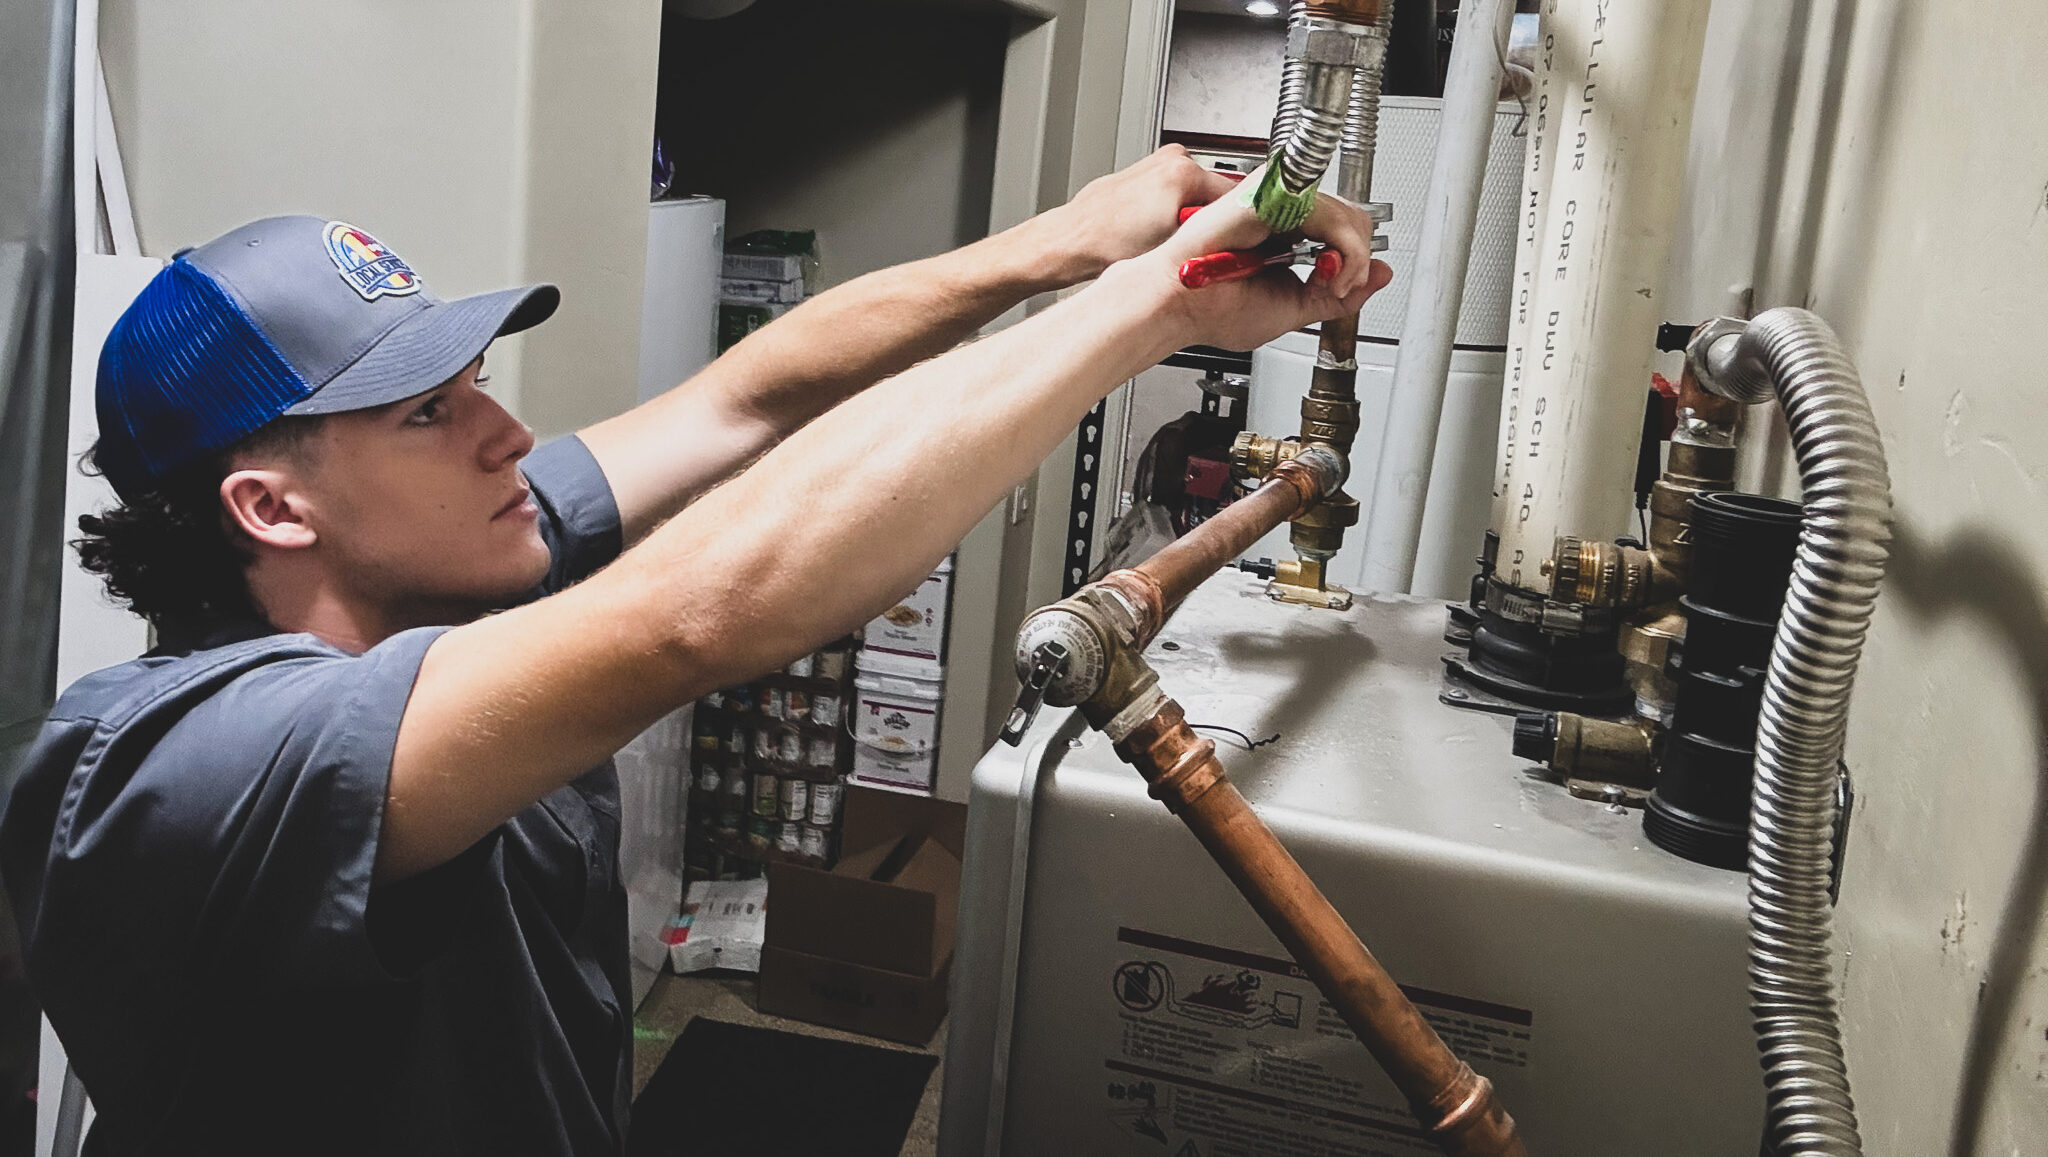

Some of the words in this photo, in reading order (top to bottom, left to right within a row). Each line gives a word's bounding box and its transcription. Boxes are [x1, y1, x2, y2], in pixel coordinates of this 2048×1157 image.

[1526, 188, 1539, 247] NOT
[1555, 200, 1577, 281] CORE
[350, 264, 385, 289] LOCAL
[1518, 271, 1531, 325] FOR
[1502, 347, 1523, 497] PRESSURE
[1529, 397, 1546, 457] SCH
[1519, 483, 1533, 521] 40
